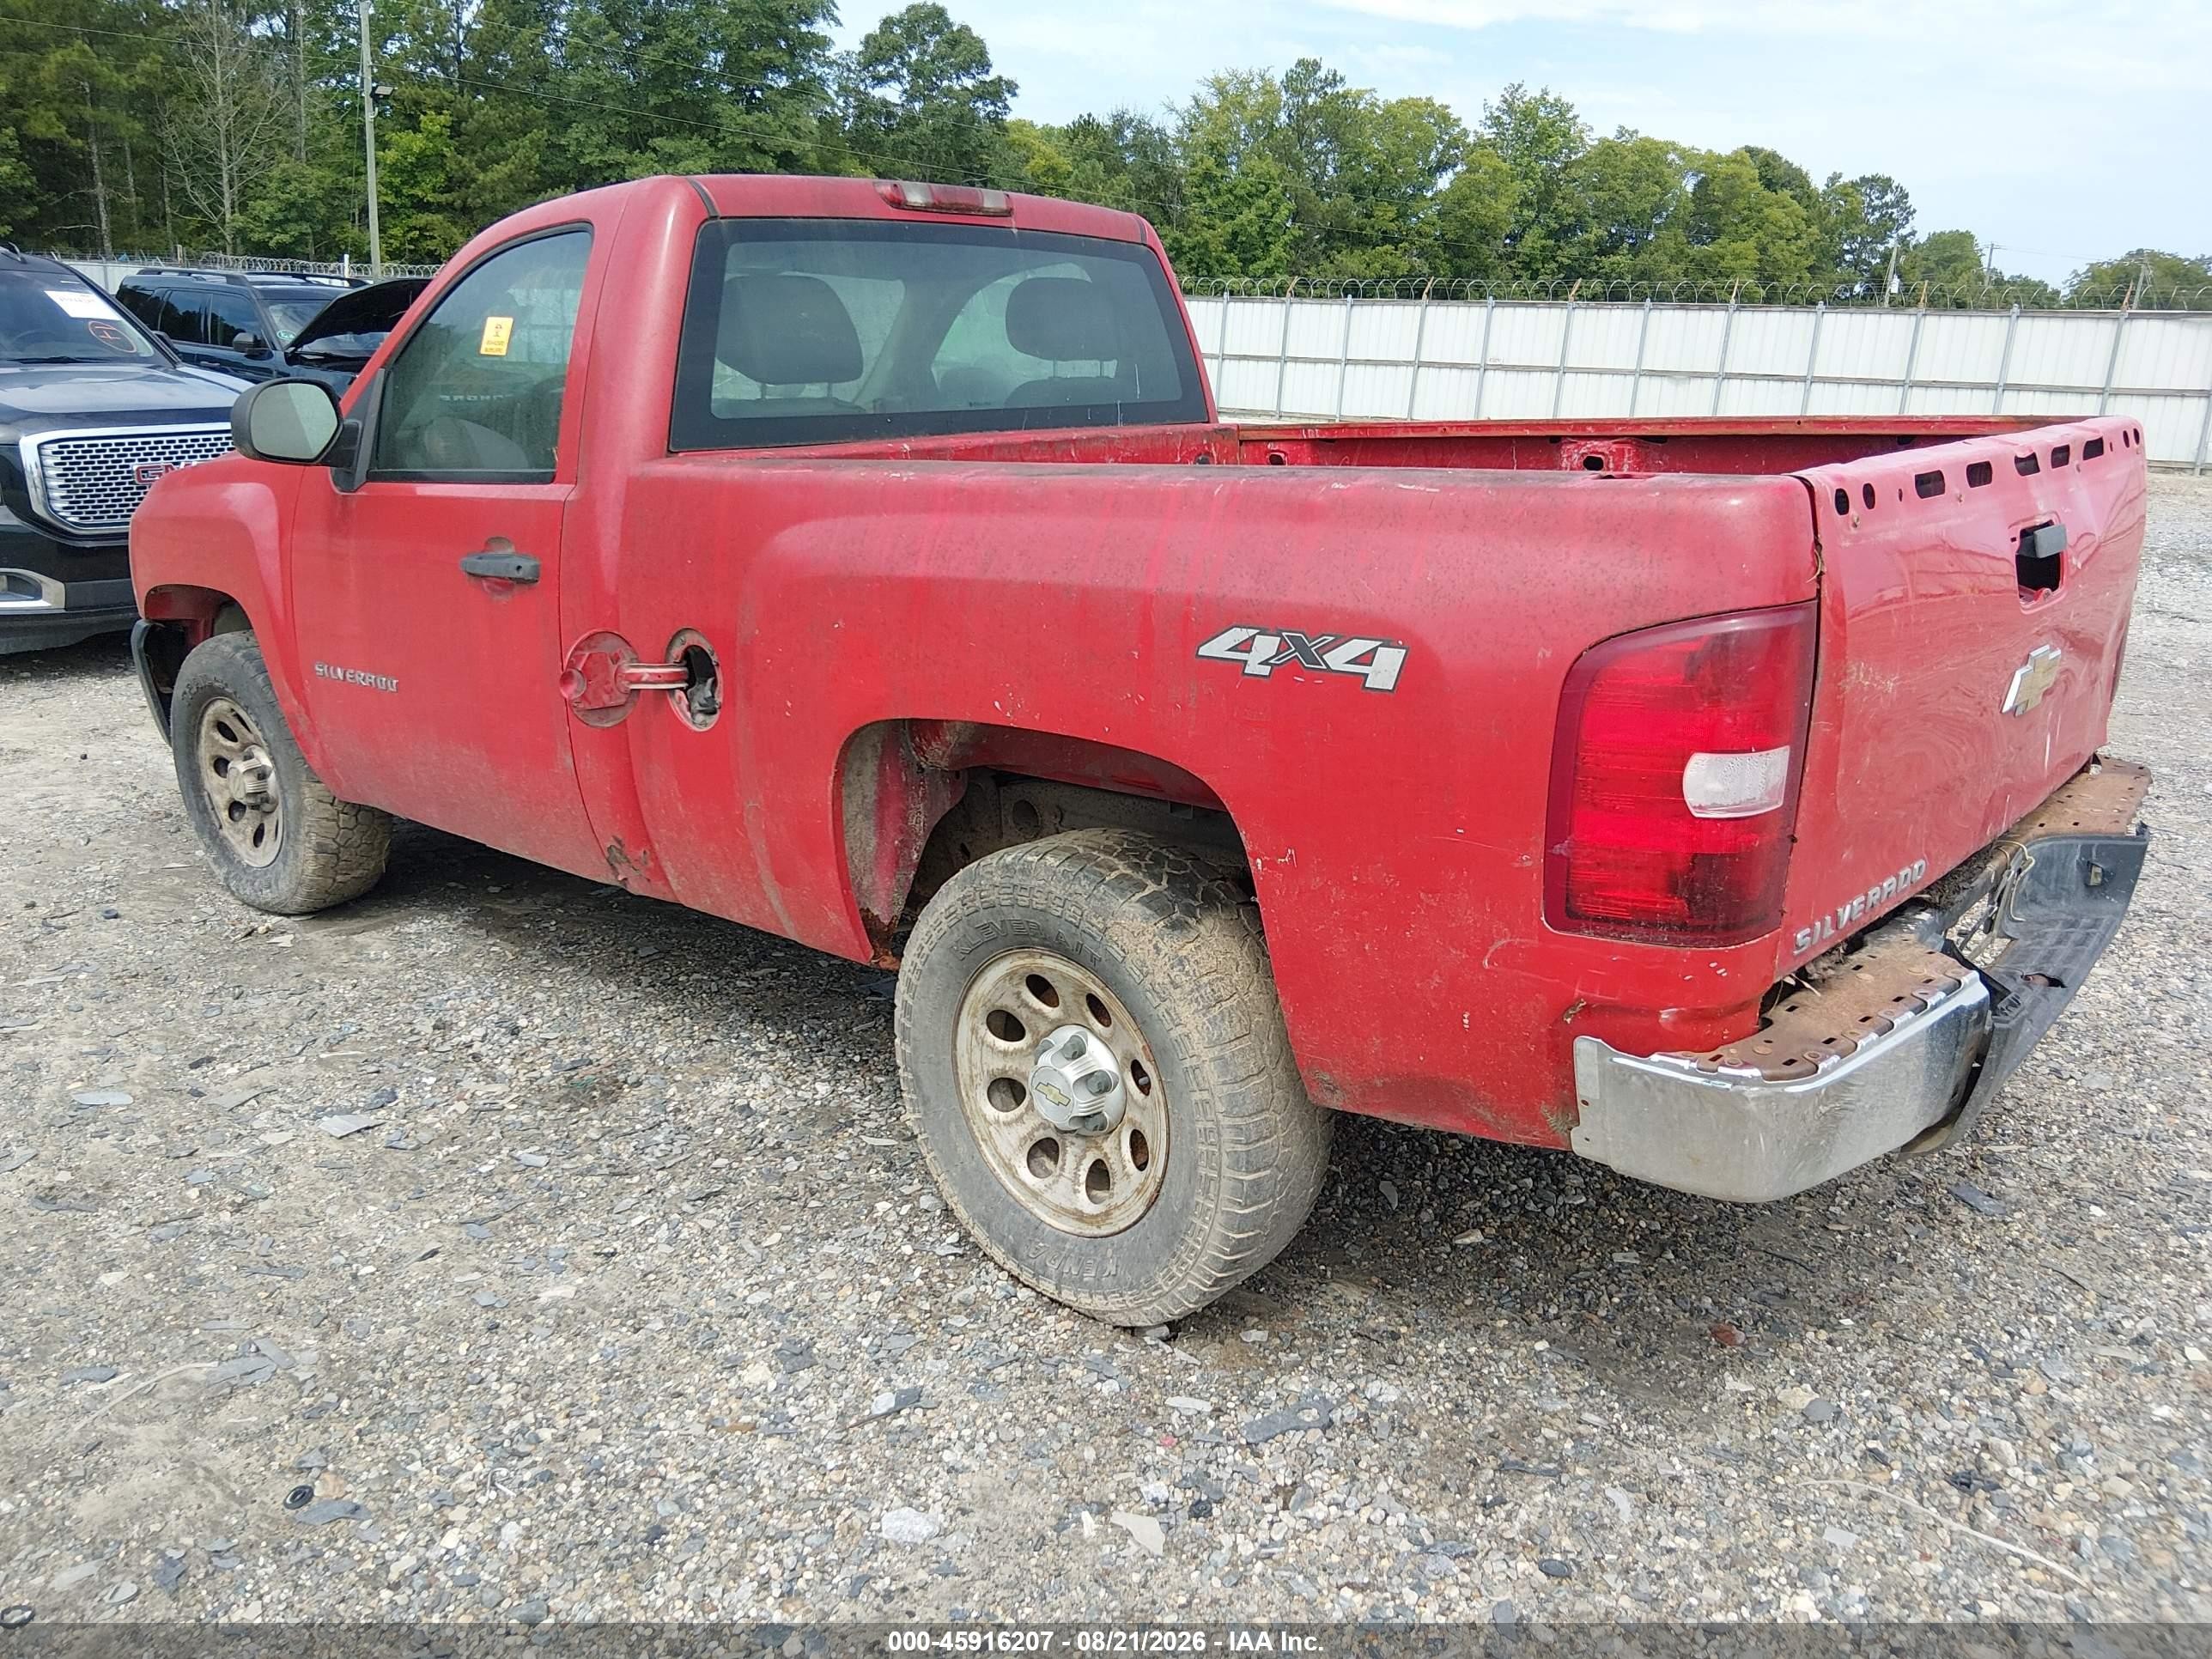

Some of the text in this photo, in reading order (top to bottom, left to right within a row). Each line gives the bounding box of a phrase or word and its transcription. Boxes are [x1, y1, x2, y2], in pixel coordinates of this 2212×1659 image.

[314, 661, 399, 693] SILVERADO
[1792, 859, 1926, 956] SILVERADO
[951, 919, 1046, 962] KLEVER
[1026, 1242, 1117, 1278] KENDA
